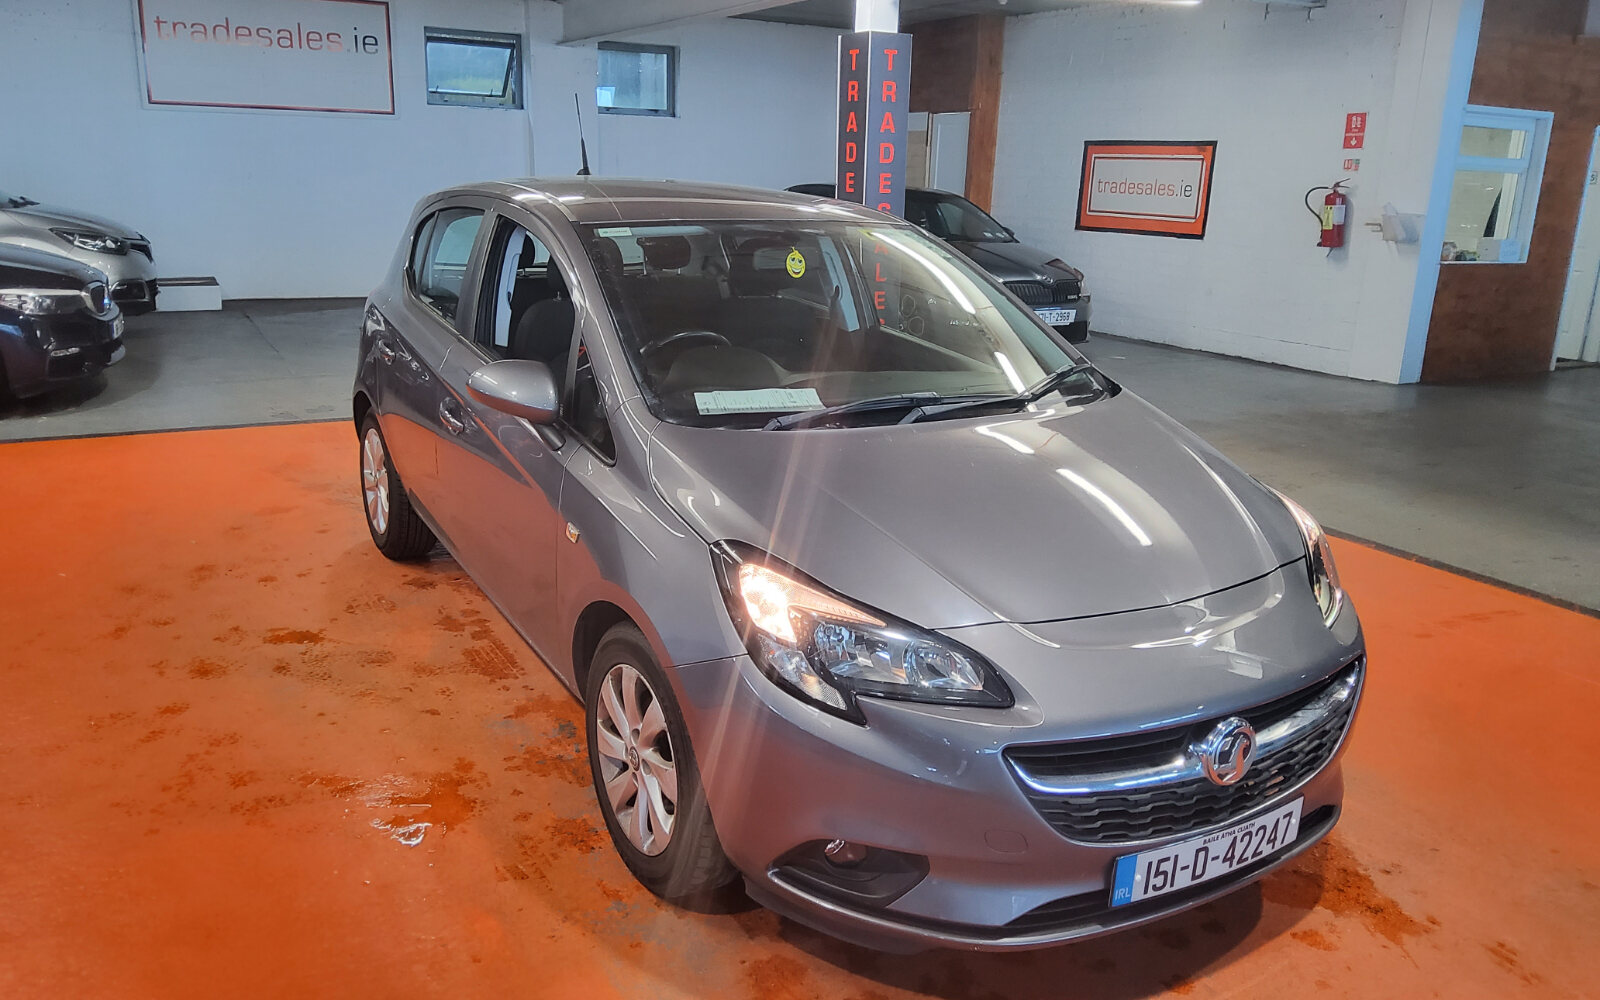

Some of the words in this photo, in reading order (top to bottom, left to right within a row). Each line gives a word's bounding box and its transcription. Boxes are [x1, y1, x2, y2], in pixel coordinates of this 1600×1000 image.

[153, 15, 379, 55] tradesales.ie
[845, 49, 859, 193] TRADE
[1097, 178, 1193, 198] tradesales.ie
[1202, 835, 1220, 845] BAILE
[1237, 821, 1256, 834] CLIATH
[1143, 811, 1294, 895] 151-D-42247
[1115, 886, 1131, 900] IRL
